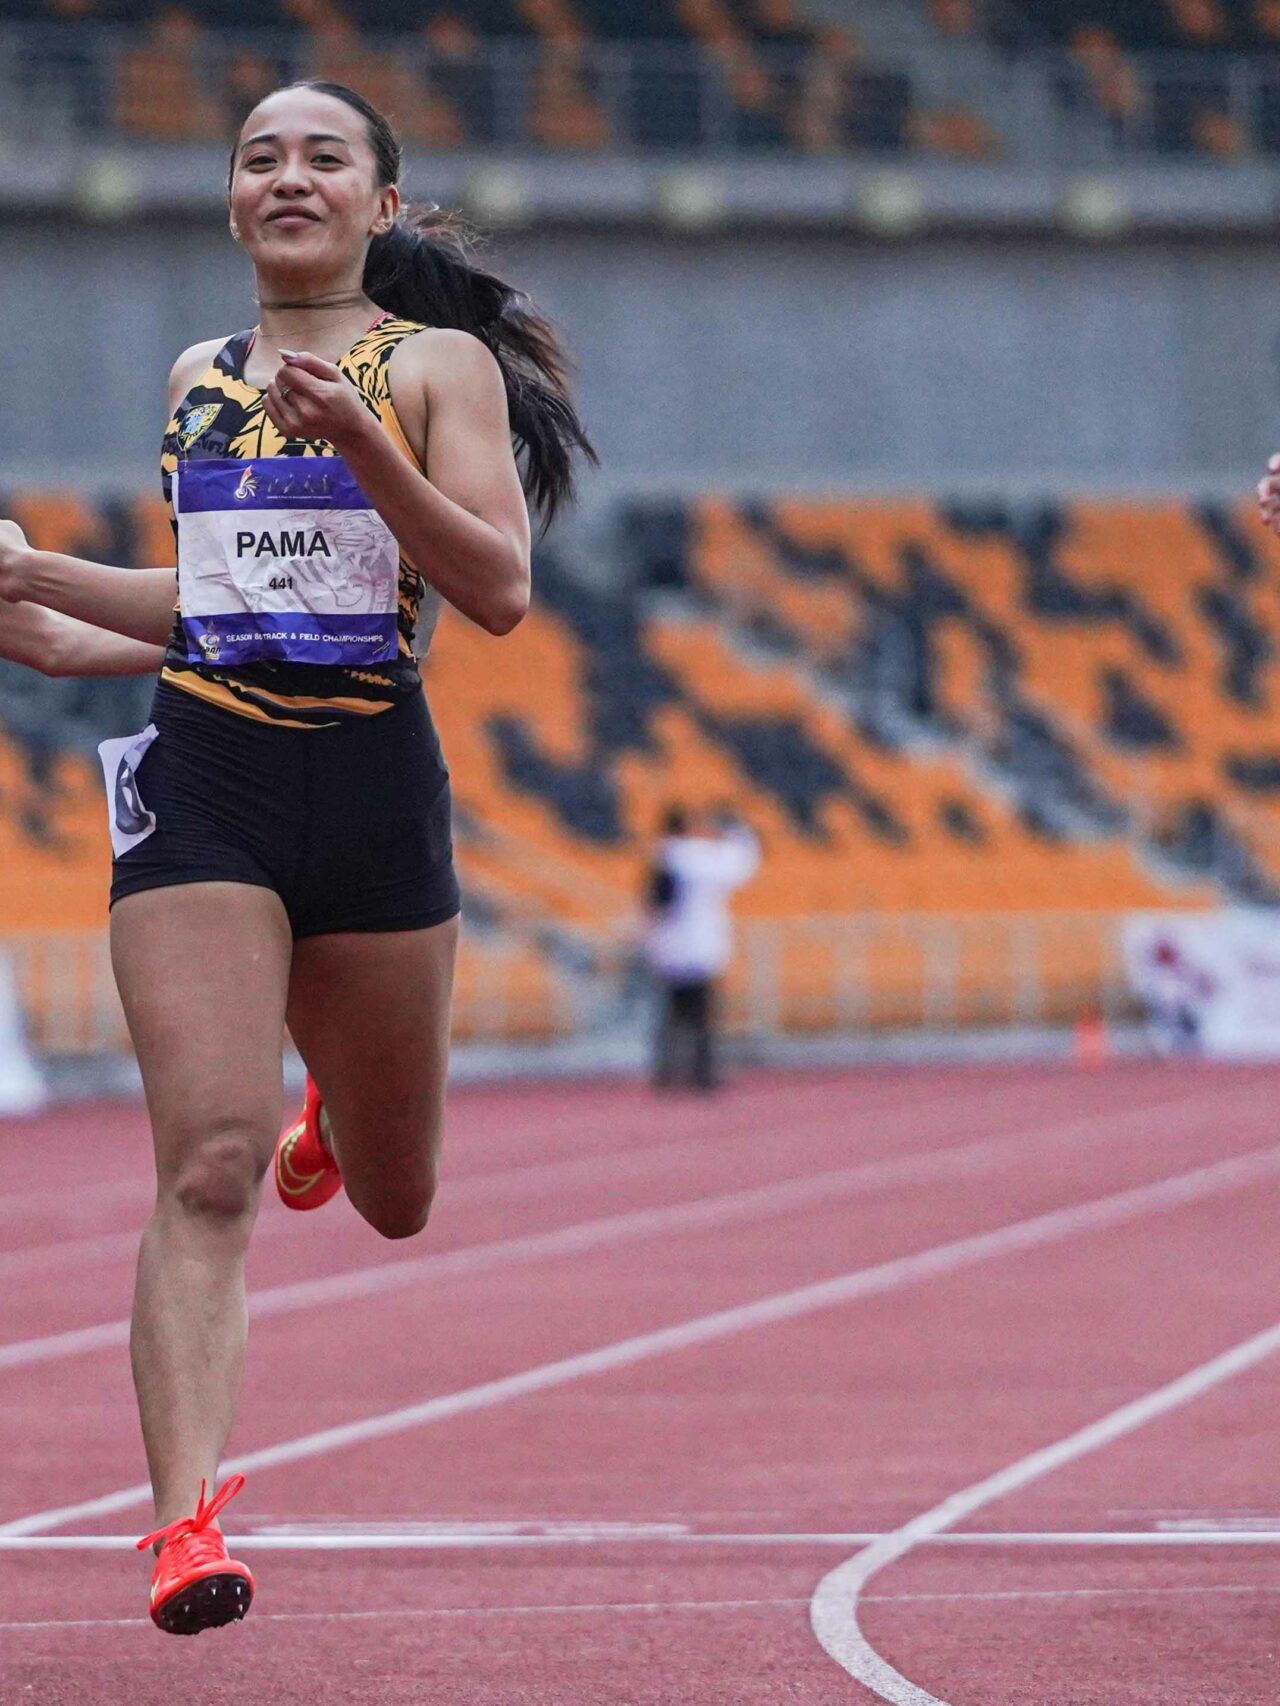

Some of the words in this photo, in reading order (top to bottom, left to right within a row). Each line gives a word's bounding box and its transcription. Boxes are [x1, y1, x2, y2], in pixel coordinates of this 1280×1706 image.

[236, 530, 332, 558] PAMA
[268, 576, 293, 590] 441
[225, 633, 253, 643] SEASON
[263, 632, 288, 640] TRACK
[290, 632, 297, 640] &
[299, 633, 320, 641] FIELD
[322, 634, 384, 643] CHAMPIONSHIPS
